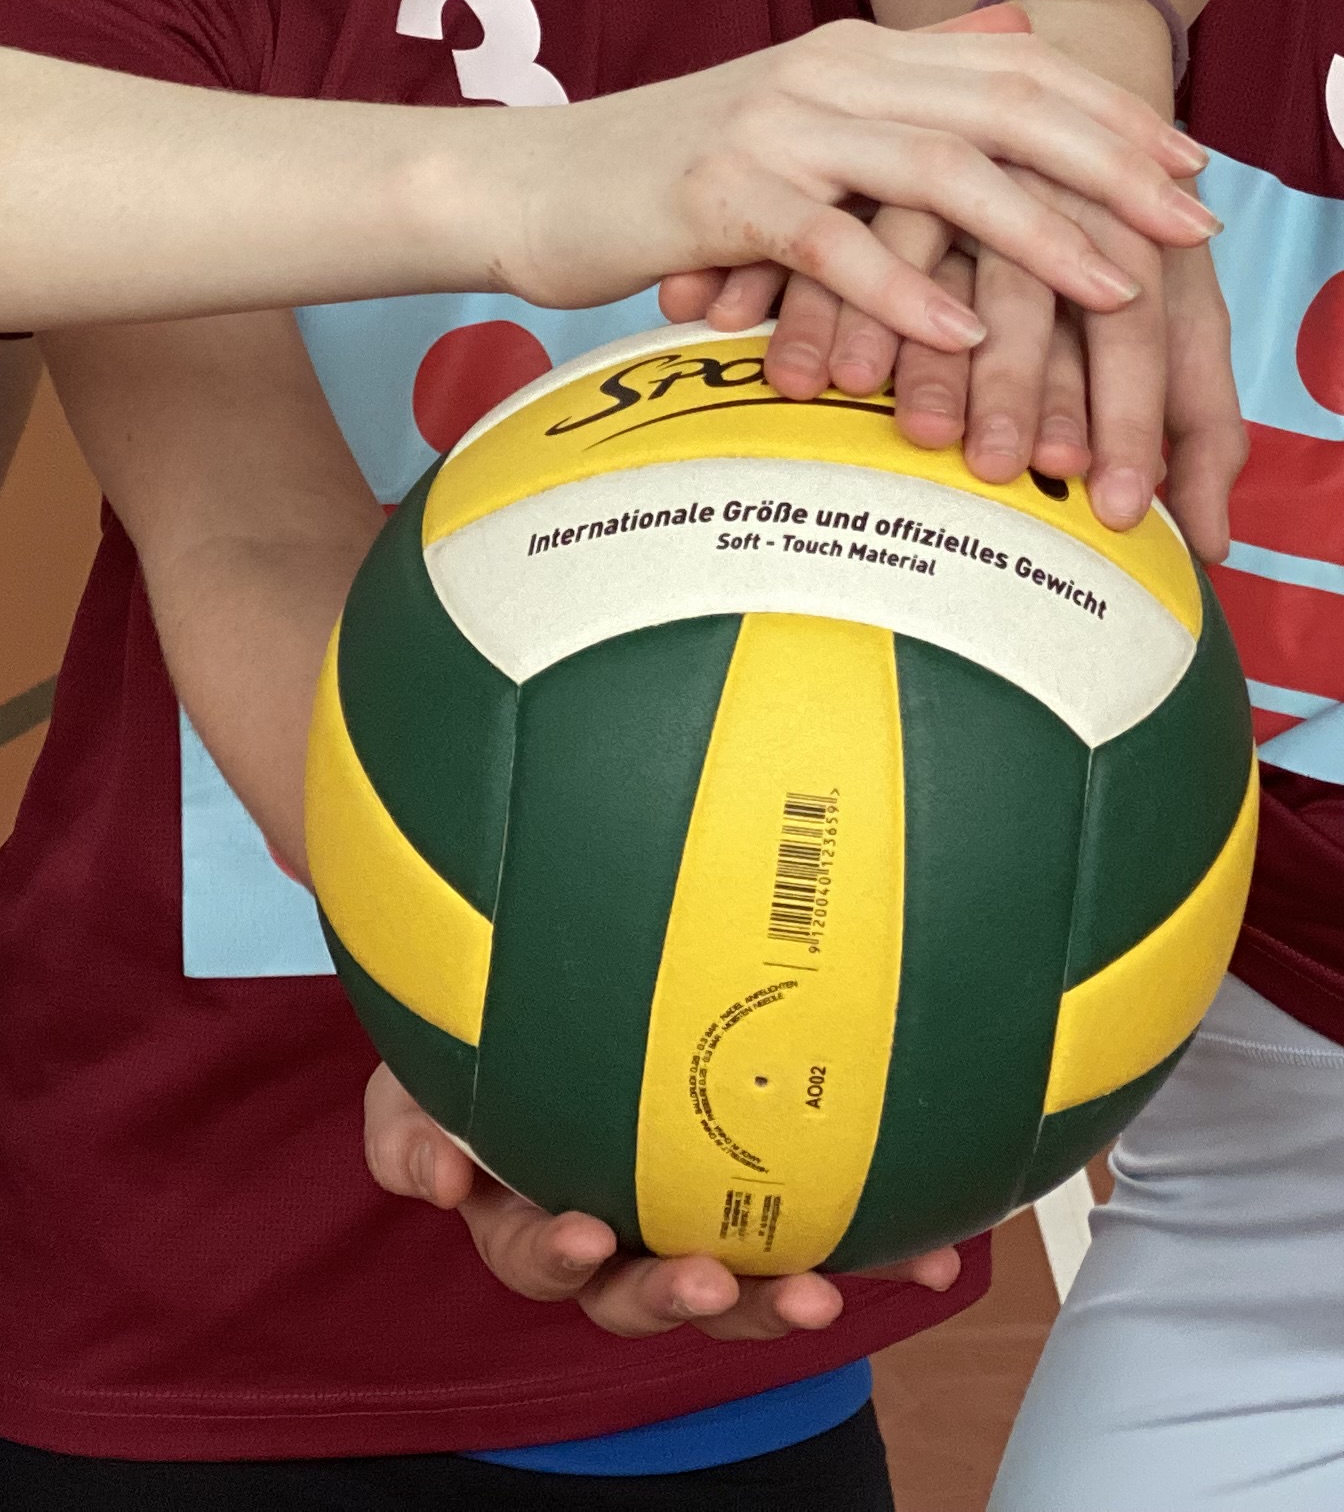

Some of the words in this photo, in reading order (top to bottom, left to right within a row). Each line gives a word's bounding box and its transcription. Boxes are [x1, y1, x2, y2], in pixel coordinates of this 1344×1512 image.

[545, 354, 768, 436] SPO
[527, 502, 715, 557] Internationale
[722, 500, 808, 525] Größe
[815, 511, 870, 532] und
[875, 517, 1009, 570] offizielles
[1015, 556, 1107, 620] Gewicht
[716, 532, 761, 550] Soft
[783, 534, 843, 557] Touch
[847, 542, 936, 576] Material
